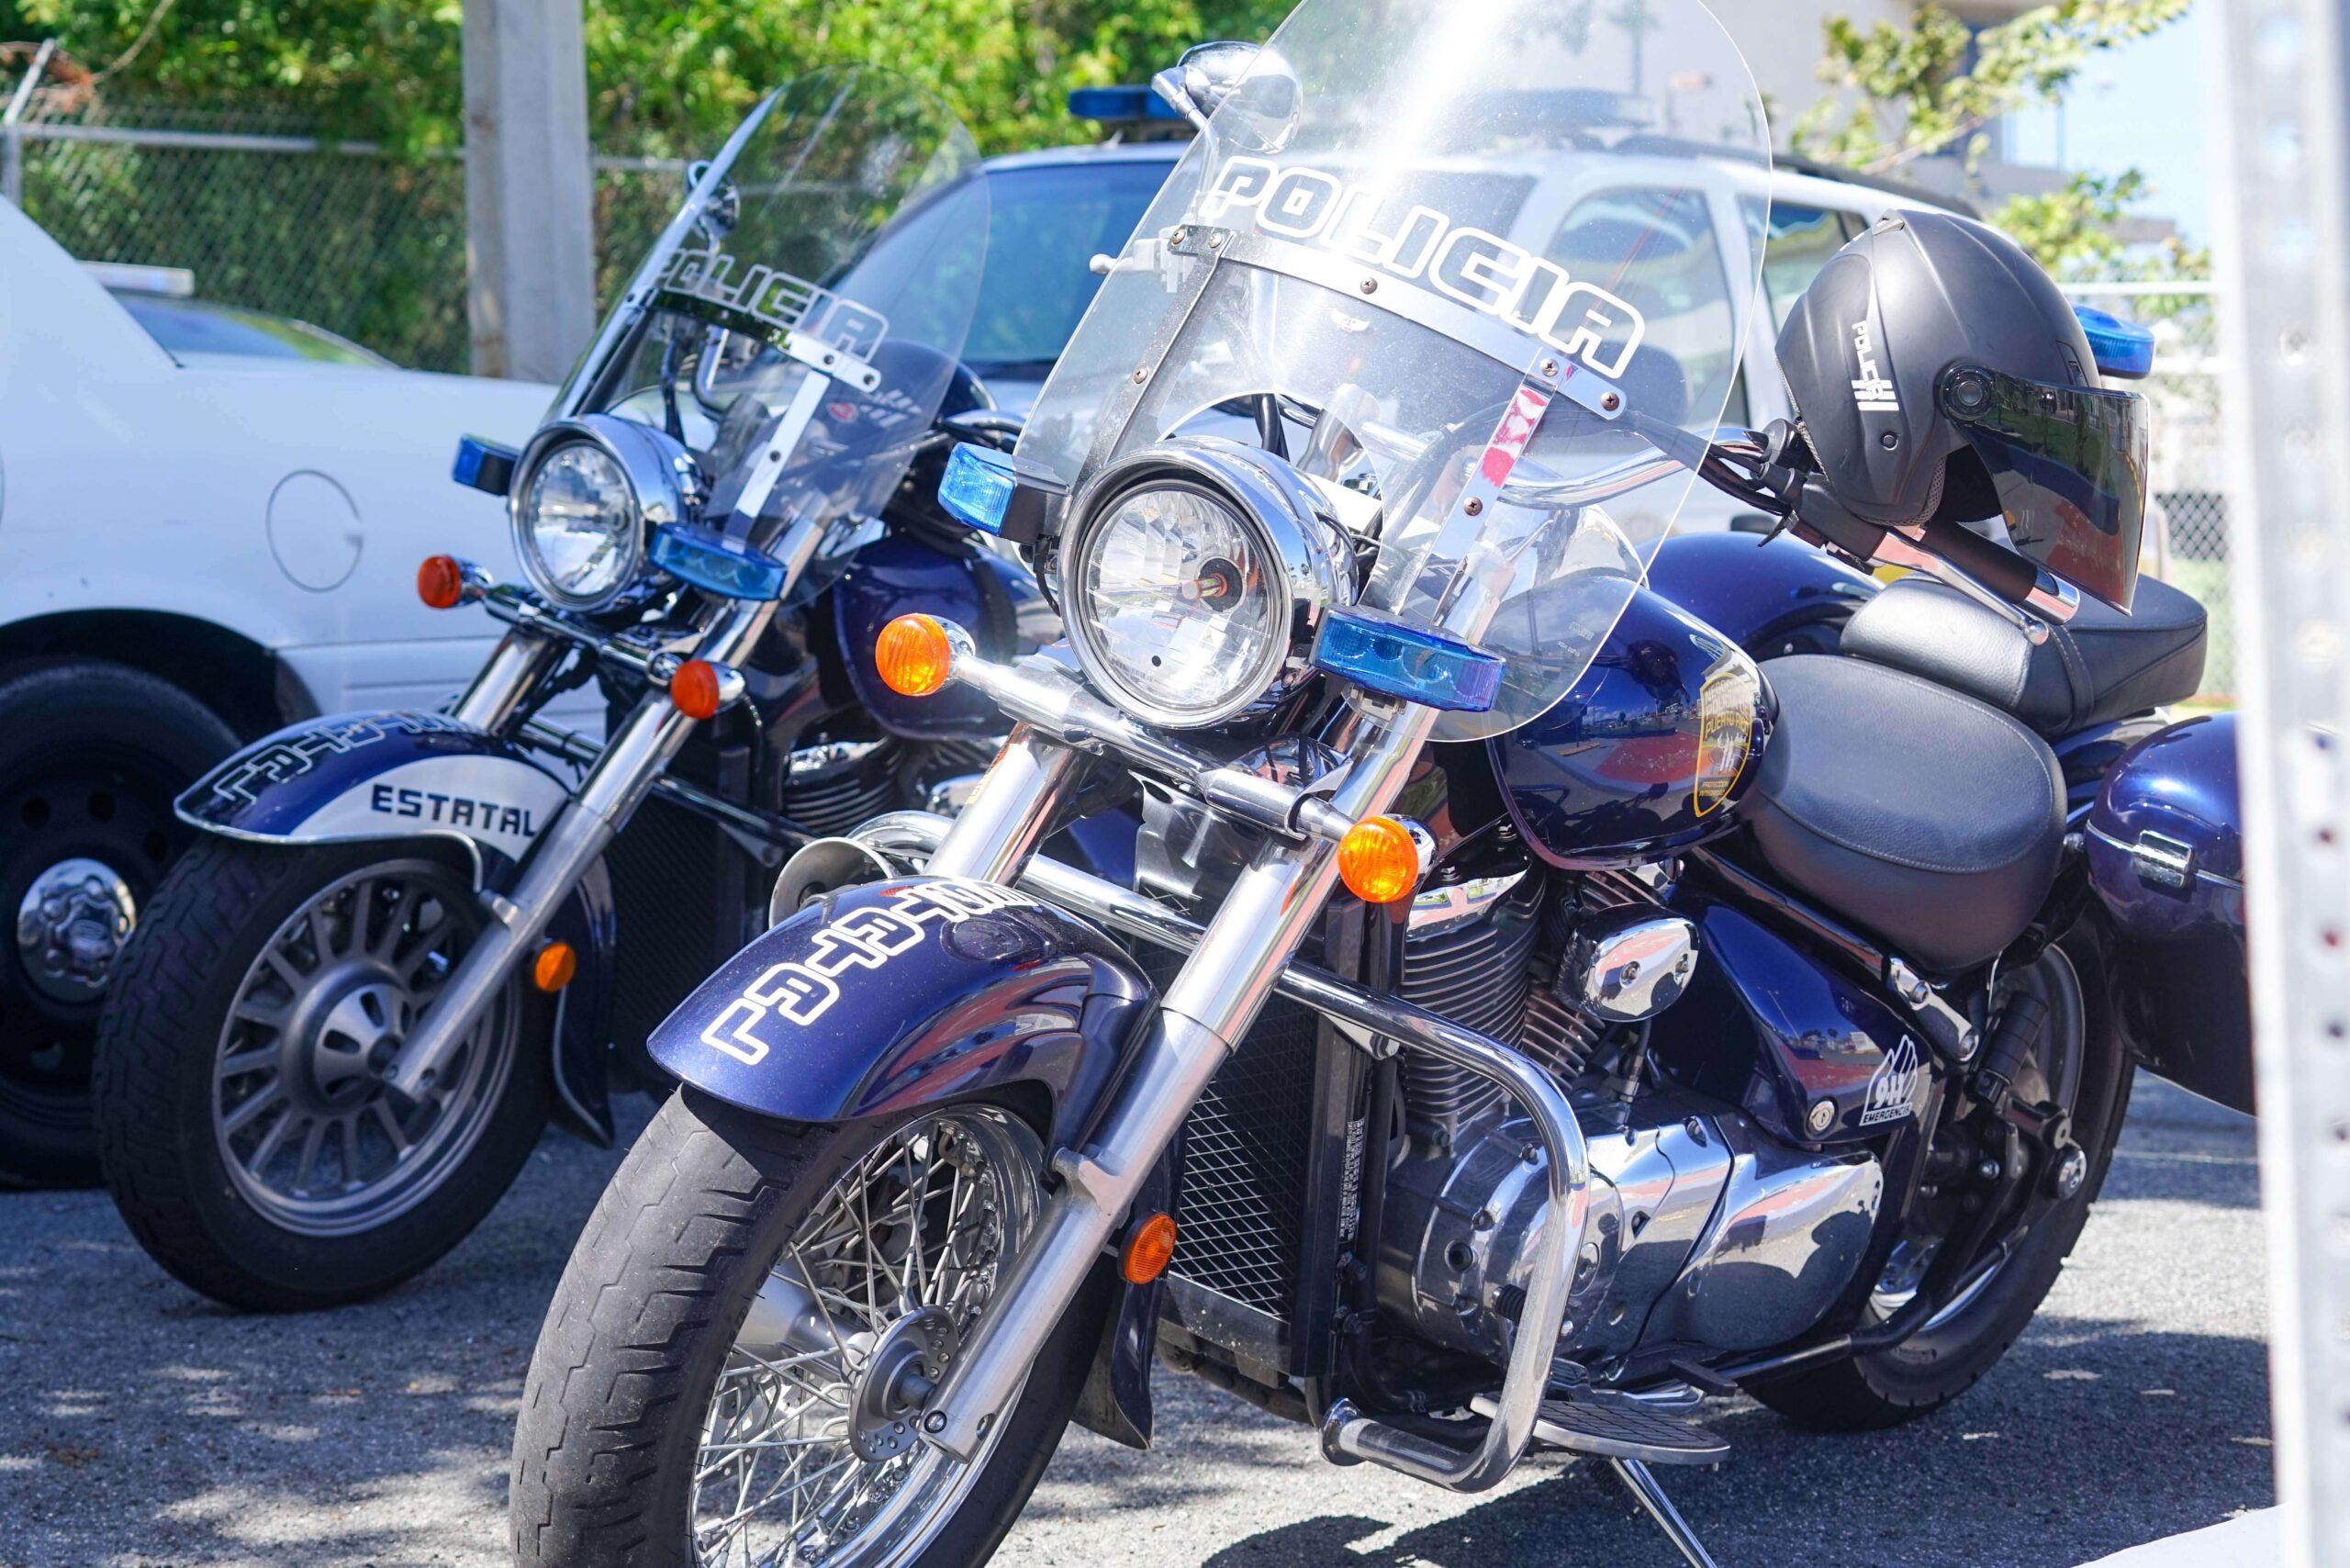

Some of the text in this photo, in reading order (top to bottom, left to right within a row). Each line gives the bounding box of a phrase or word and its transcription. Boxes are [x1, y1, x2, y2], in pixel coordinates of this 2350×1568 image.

[1198, 155, 1646, 379] POLICIA
[1852, 319, 1885, 401] POLICIA
[1705, 711, 1735, 739] PUERTO
[371, 783, 538, 837] ESTATAL
